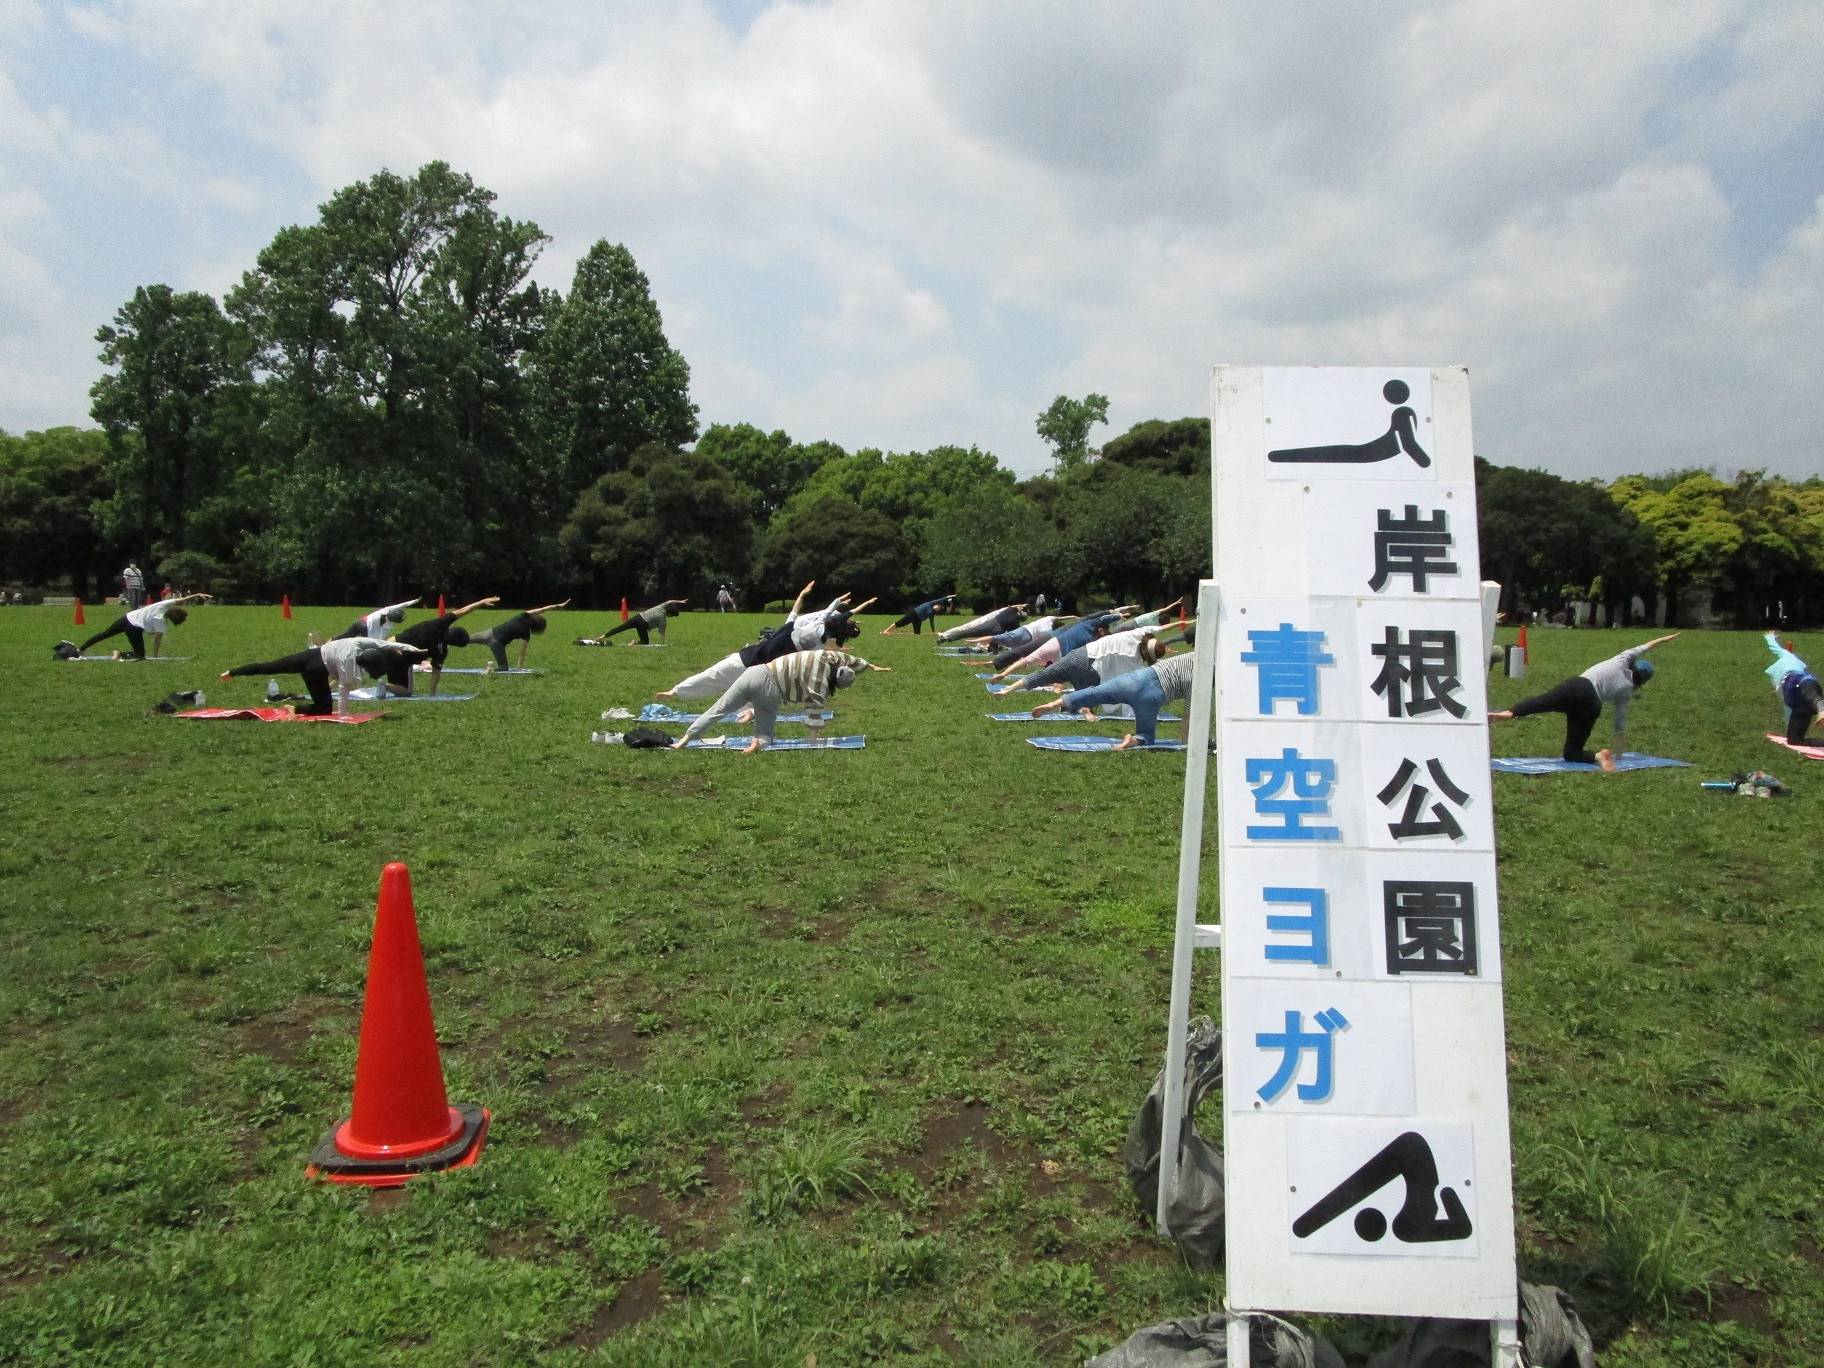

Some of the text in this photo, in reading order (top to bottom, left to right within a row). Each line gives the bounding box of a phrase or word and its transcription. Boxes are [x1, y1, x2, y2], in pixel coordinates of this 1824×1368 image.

[1241, 623, 1348, 1102] 青空ヨガ
[1367, 504, 1477, 975] 岸根公園
